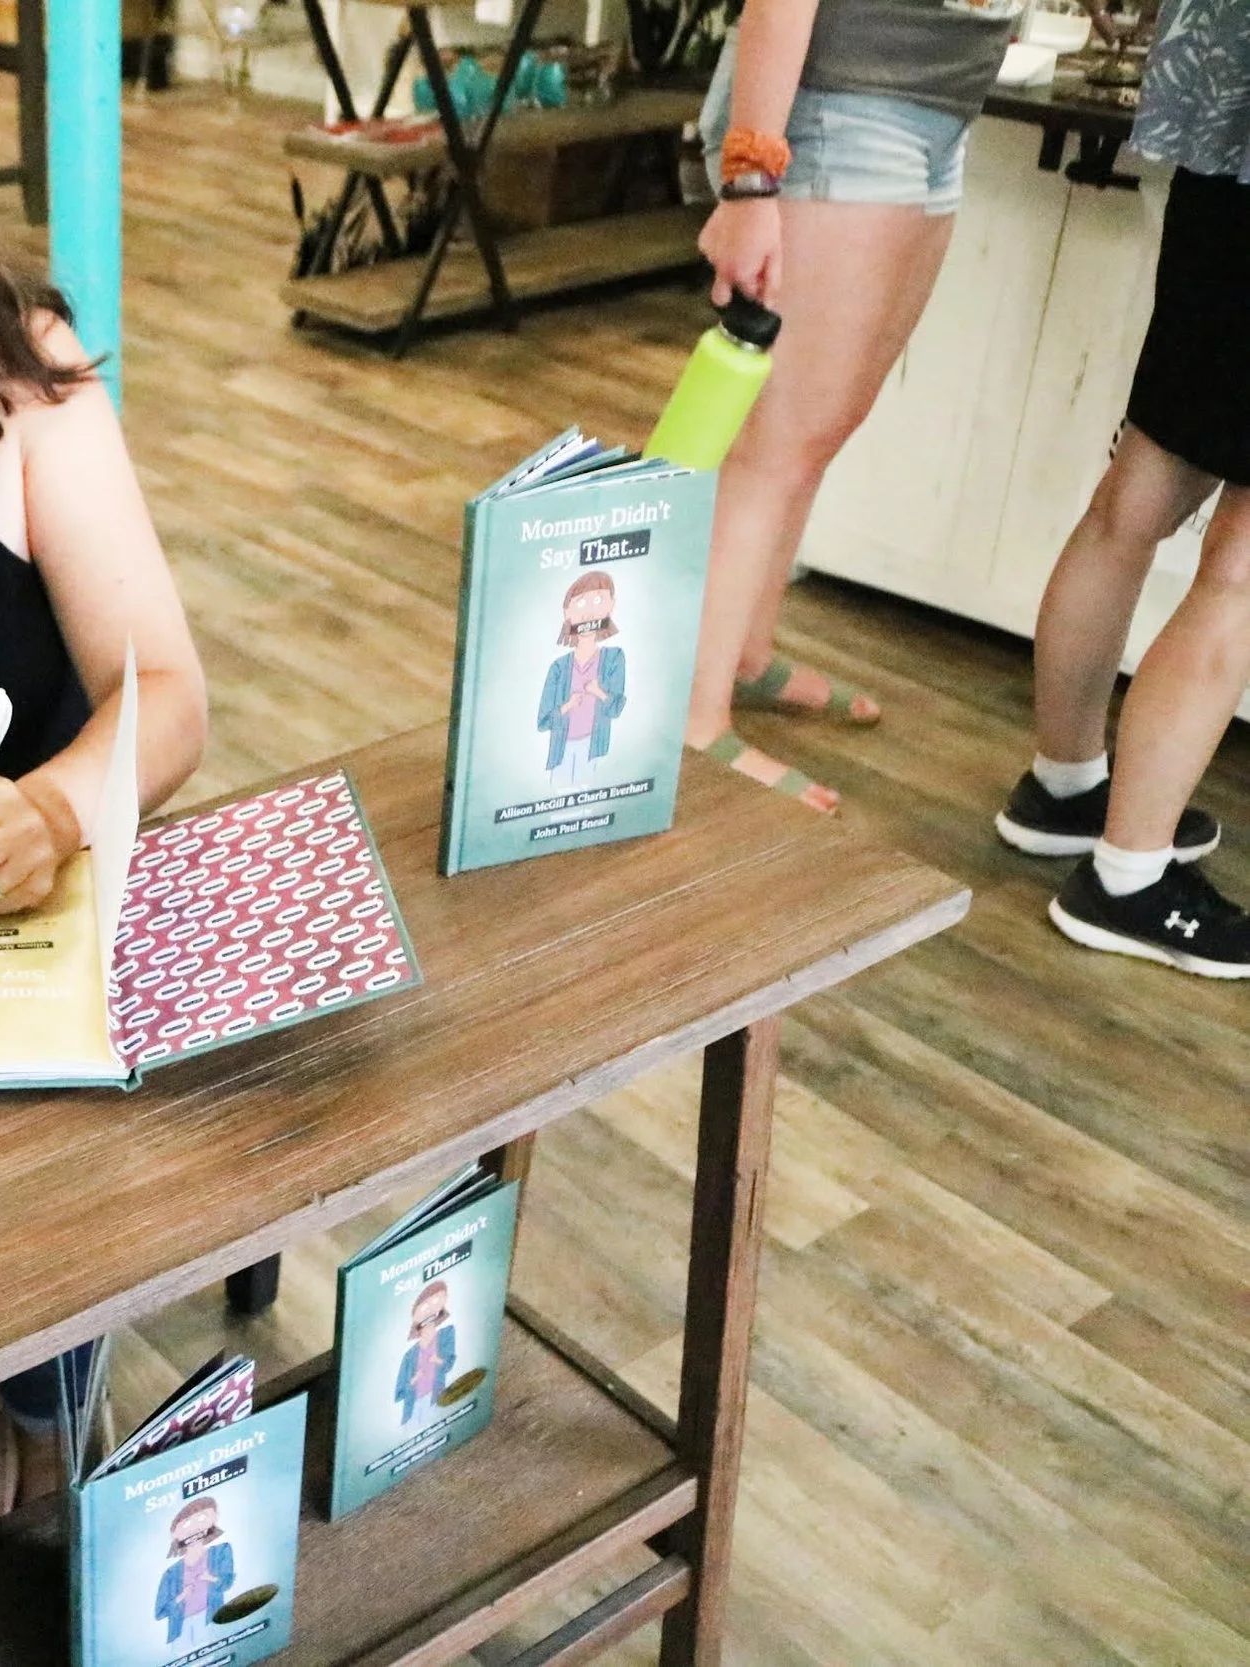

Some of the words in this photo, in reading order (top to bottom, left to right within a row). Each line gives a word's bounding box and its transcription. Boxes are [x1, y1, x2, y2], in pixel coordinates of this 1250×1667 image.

[520, 514, 605, 542] Mommy
[611, 500, 671, 528] Didn't
[540, 547, 577, 570] Say
[582, 539, 646, 562] That...
[499, 806, 533, 820] Allison
[534, 797, 566, 813] McGill
[567, 796, 576, 806] &
[609, 781, 649, 799] Everhart
[533, 827, 558, 840] John
[559, 820, 580, 834] Paul
[581, 815, 610, 830] Snead
[380, 1243, 441, 1285] Mommy
[444, 1216, 487, 1249] Didn't
[393, 1274, 420, 1296] Say
[424, 1252, 470, 1279] That...
[124, 1458, 204, 1501] Mommy
[209, 1431, 267, 1464] Didn't
[144, 1490, 178, 1513] Say
[183, 1467, 245, 1496] That...
